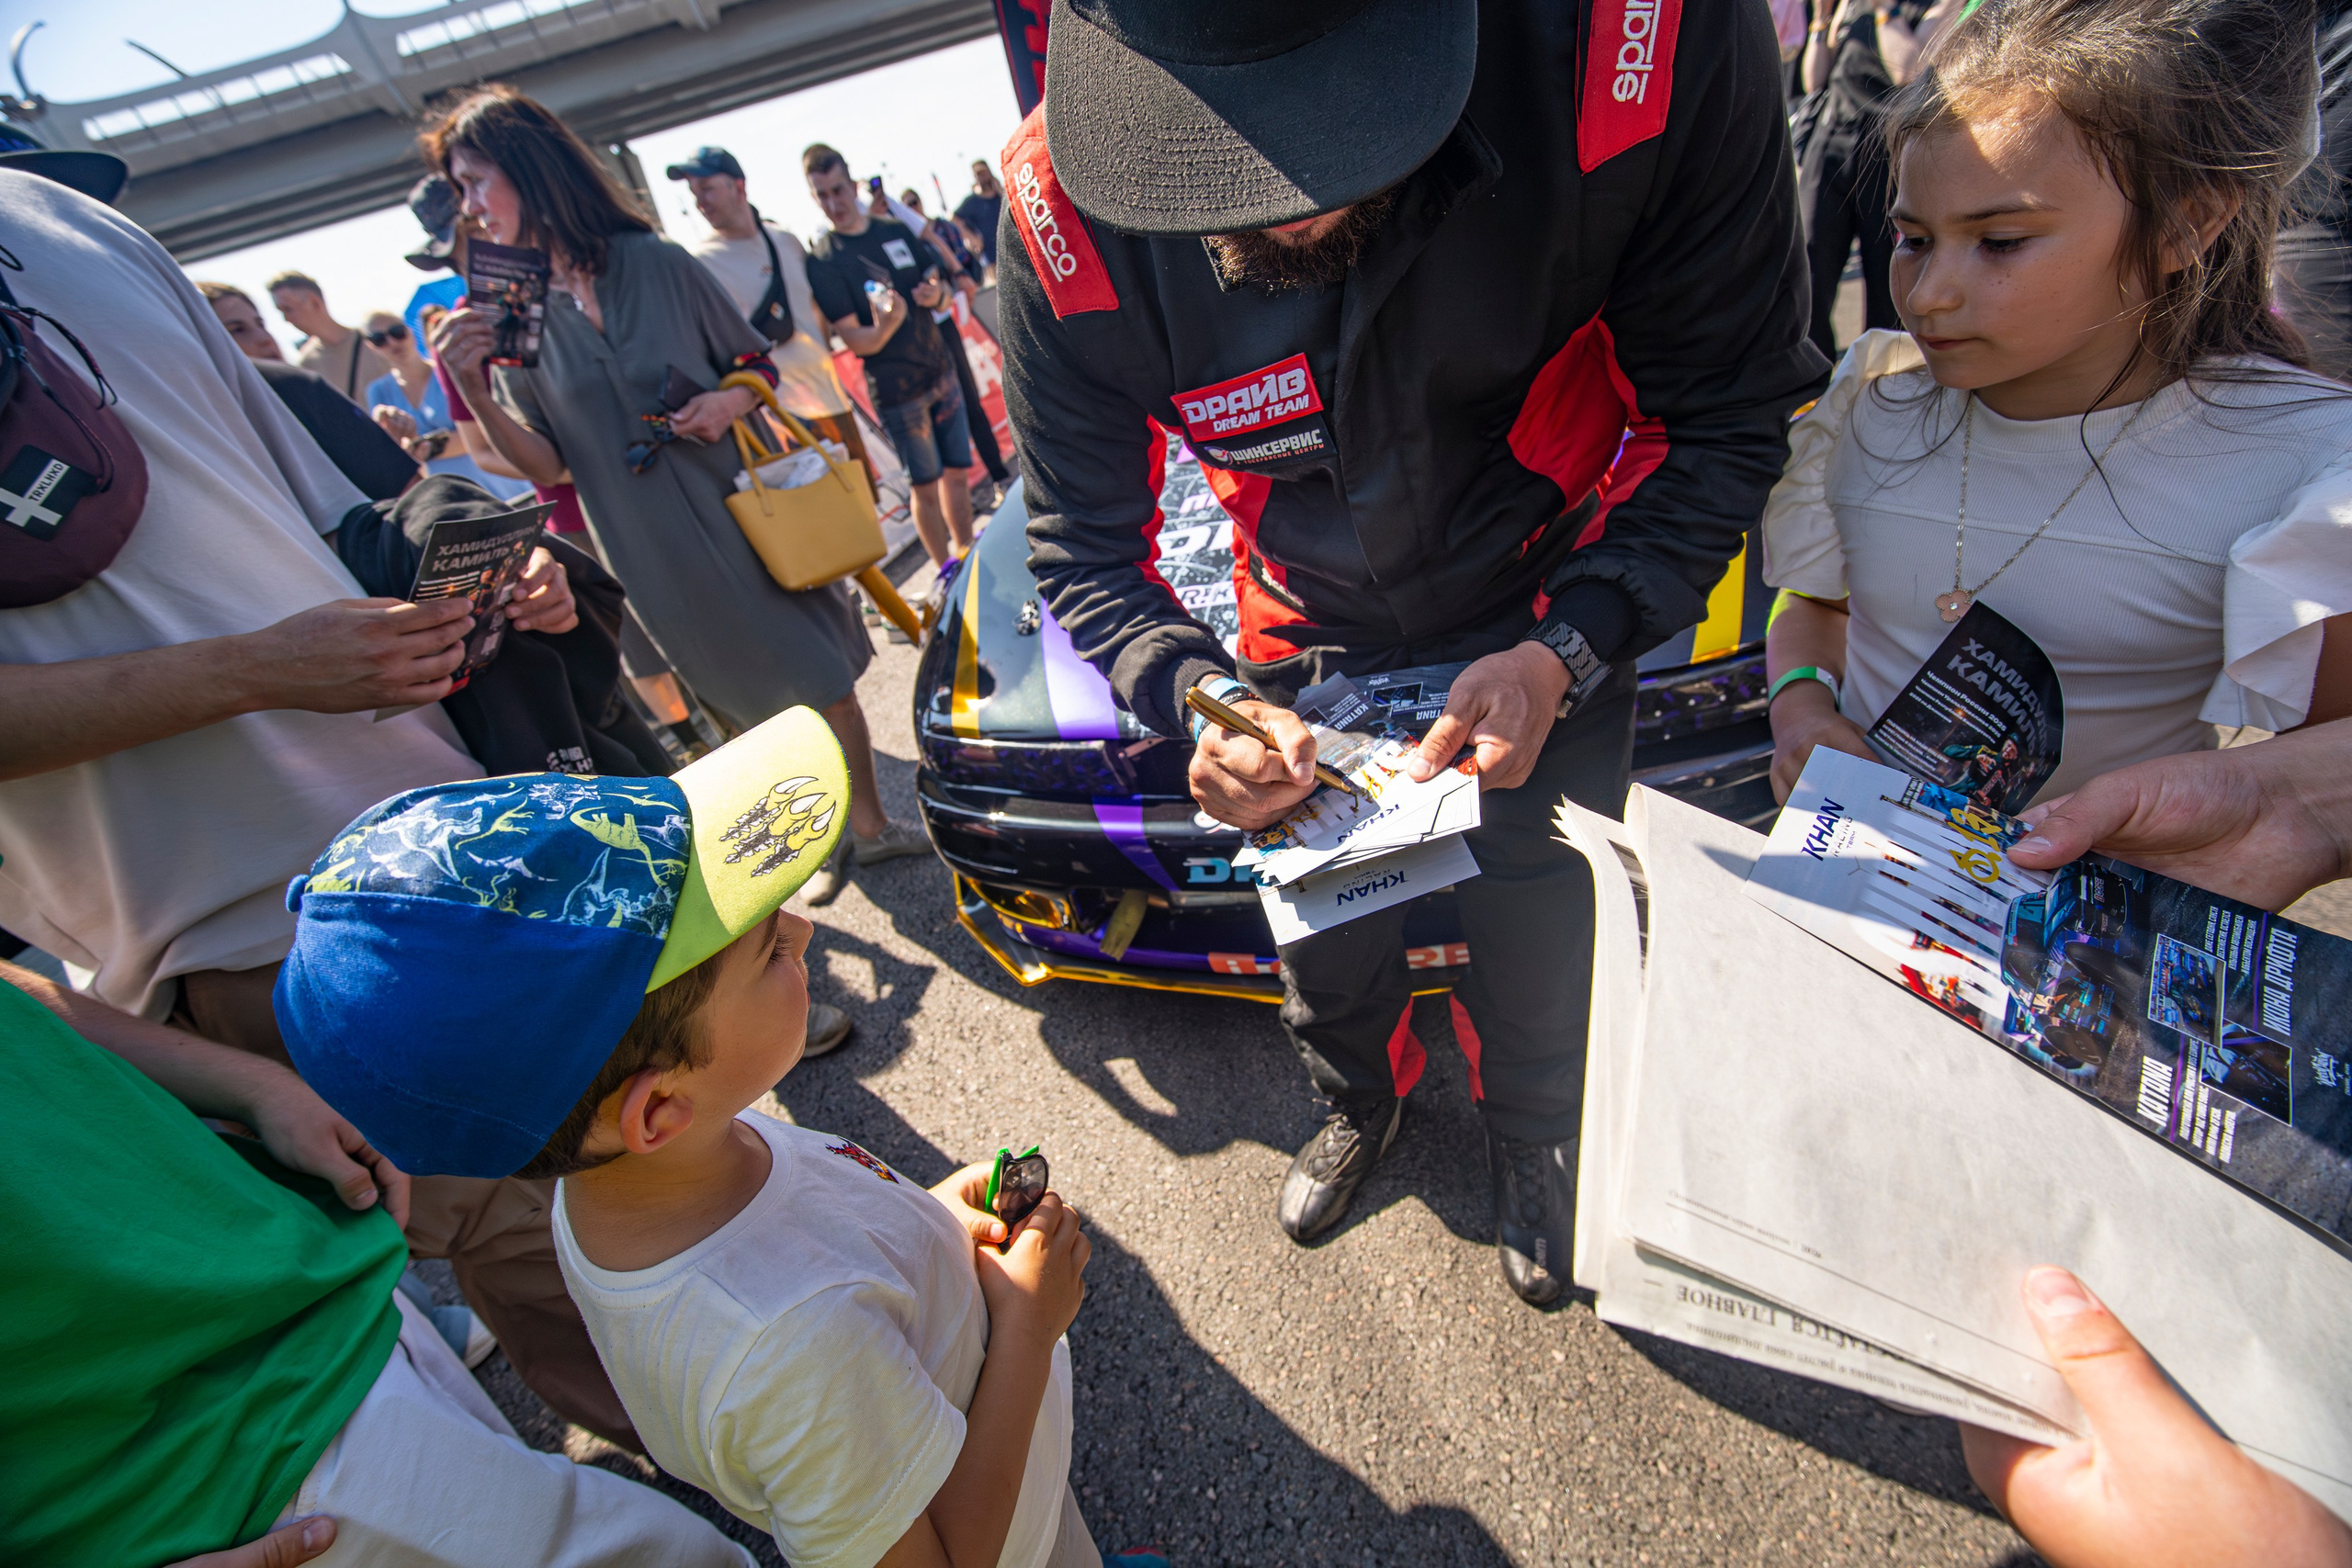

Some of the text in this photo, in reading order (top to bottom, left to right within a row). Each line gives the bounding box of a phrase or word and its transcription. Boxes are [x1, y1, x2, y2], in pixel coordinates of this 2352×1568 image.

[1014, 162, 1077, 282] sparco
[1214, 394, 1309, 433] DREAM TEAM
[1231, 428, 1323, 461] ШИНСЕРВИС
[1295, 443, 1325, 456] ЦЕНТРЫ
[28, 463, 64, 502] TRXLHXD
[432, 546, 511, 572] КАМИЛЬ
[1416, 707, 1443, 720] TANA
[1927, 671, 1962, 697] Чемпион
[1960, 694, 1990, 717] России
[1334, 703, 1369, 730] KATANA
[1801, 796, 1845, 862] KHAN
[1829, 816, 1853, 858] RACING
[1337, 871, 1409, 906] KHAN
[1343, 868, 1391, 889] RACING
[2263, 927, 2298, 1037] ИКОНА ДРИФТА
[2136, 1055, 2174, 1128] KATANA
[1677, 1285, 1777, 1327] ГЛАВНОЕ
